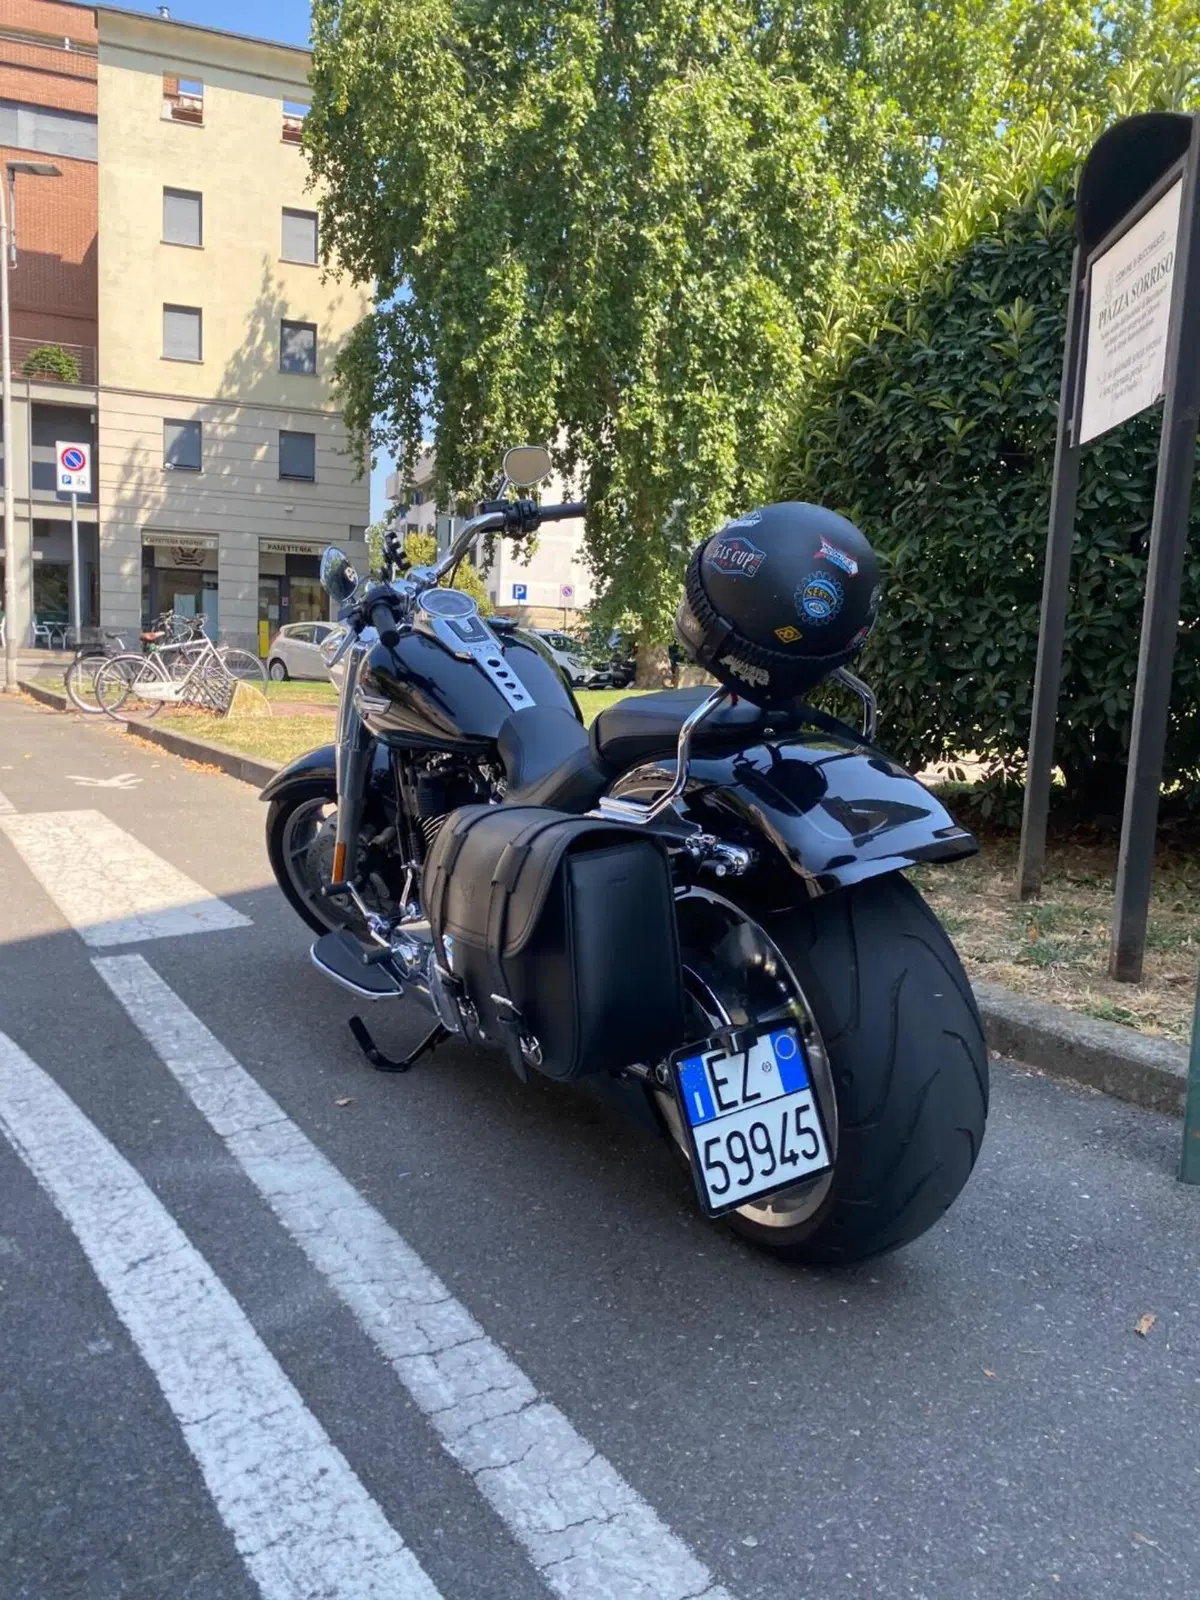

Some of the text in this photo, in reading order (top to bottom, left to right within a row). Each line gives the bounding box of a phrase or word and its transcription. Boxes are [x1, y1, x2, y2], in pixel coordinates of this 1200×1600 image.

[1098, 290, 1129, 329] PIAZZA
[1131, 252, 1174, 303] SORRISO
[267, 543, 312, 553] PANETTERIA
[731, 550, 755, 568] CUP
[515, 585, 524, 598] P
[706, 1050, 761, 1112] EZ
[694, 1092, 705, 1117] I
[704, 1104, 820, 1195] 59945
